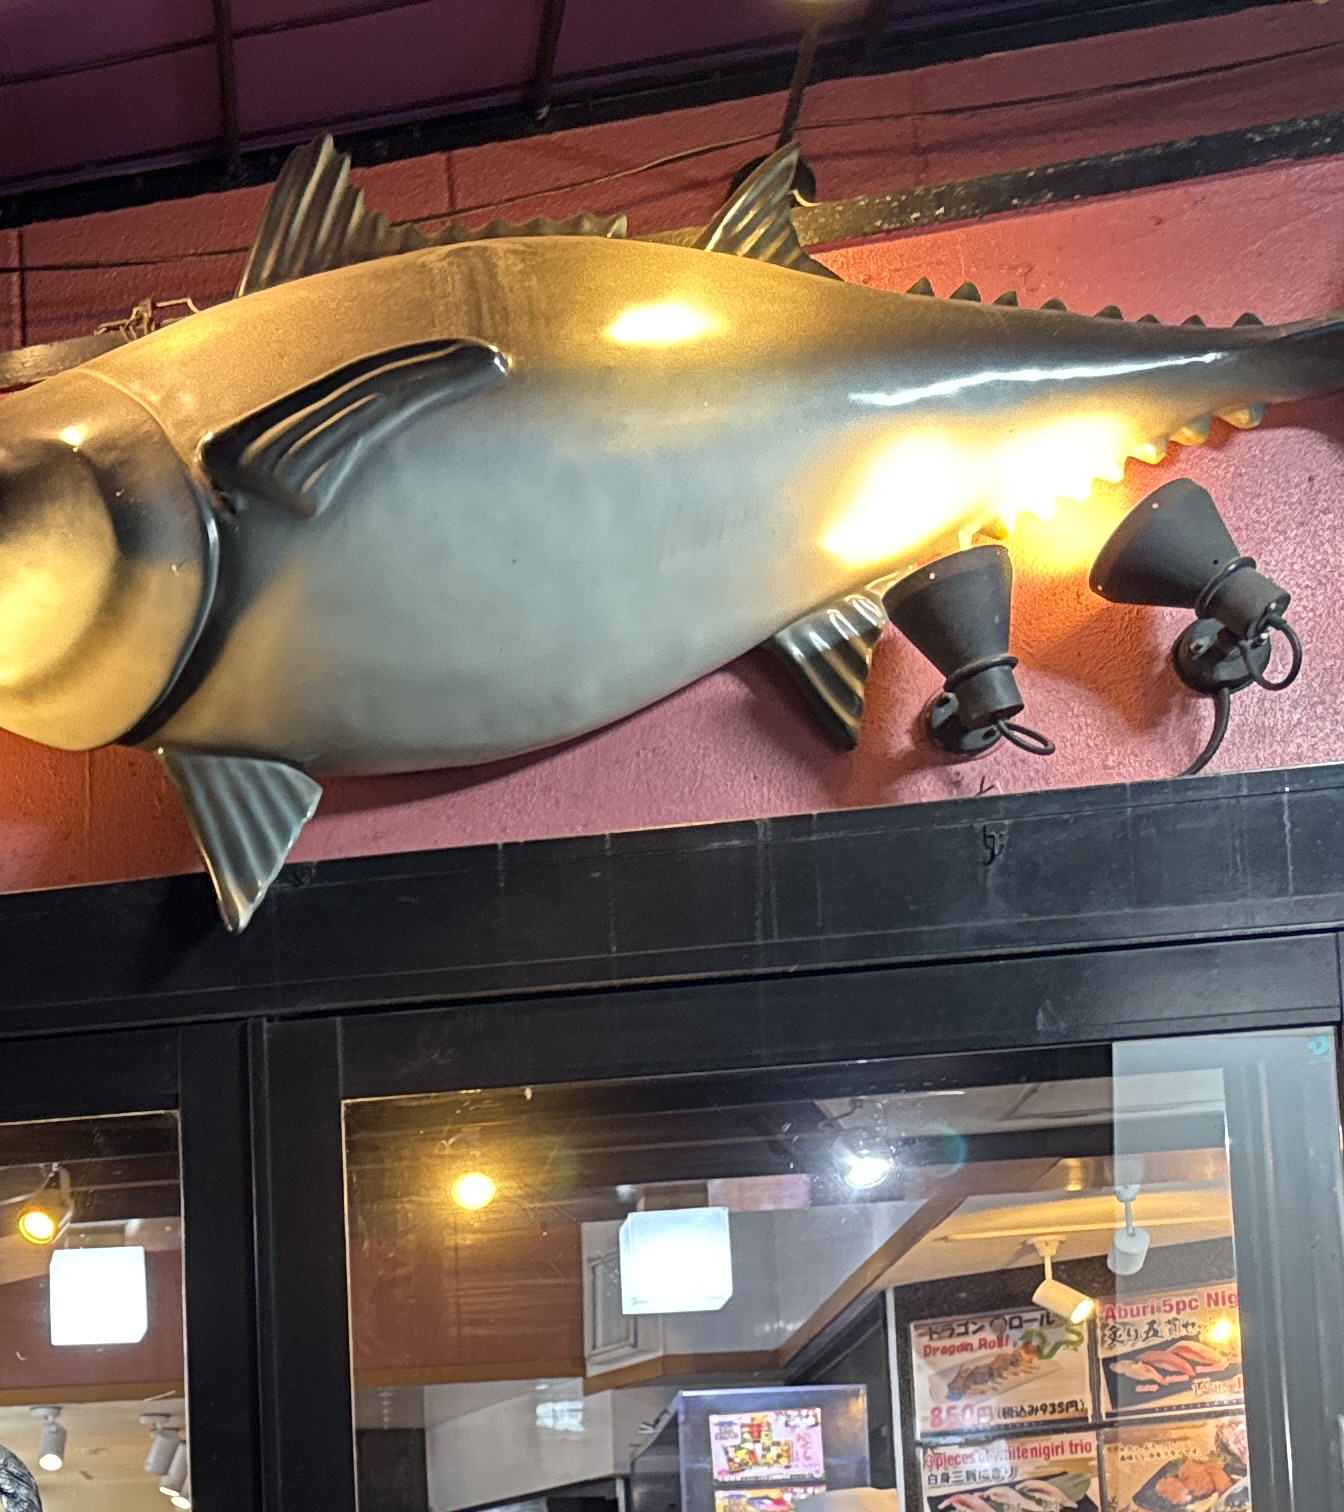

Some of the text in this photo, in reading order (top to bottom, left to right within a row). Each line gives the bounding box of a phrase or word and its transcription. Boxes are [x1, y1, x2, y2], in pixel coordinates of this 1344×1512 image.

[1104, 1302, 1156, 1321] Aburi
[1162, 1296, 1200, 1315] 5pc
[924, 1339, 974, 1358] Dragon
[930, 1405, 994, 1428] 850円
[1030, 1441, 1065, 1461] nigiri
[1069, 1440, 1092, 1456] trio
